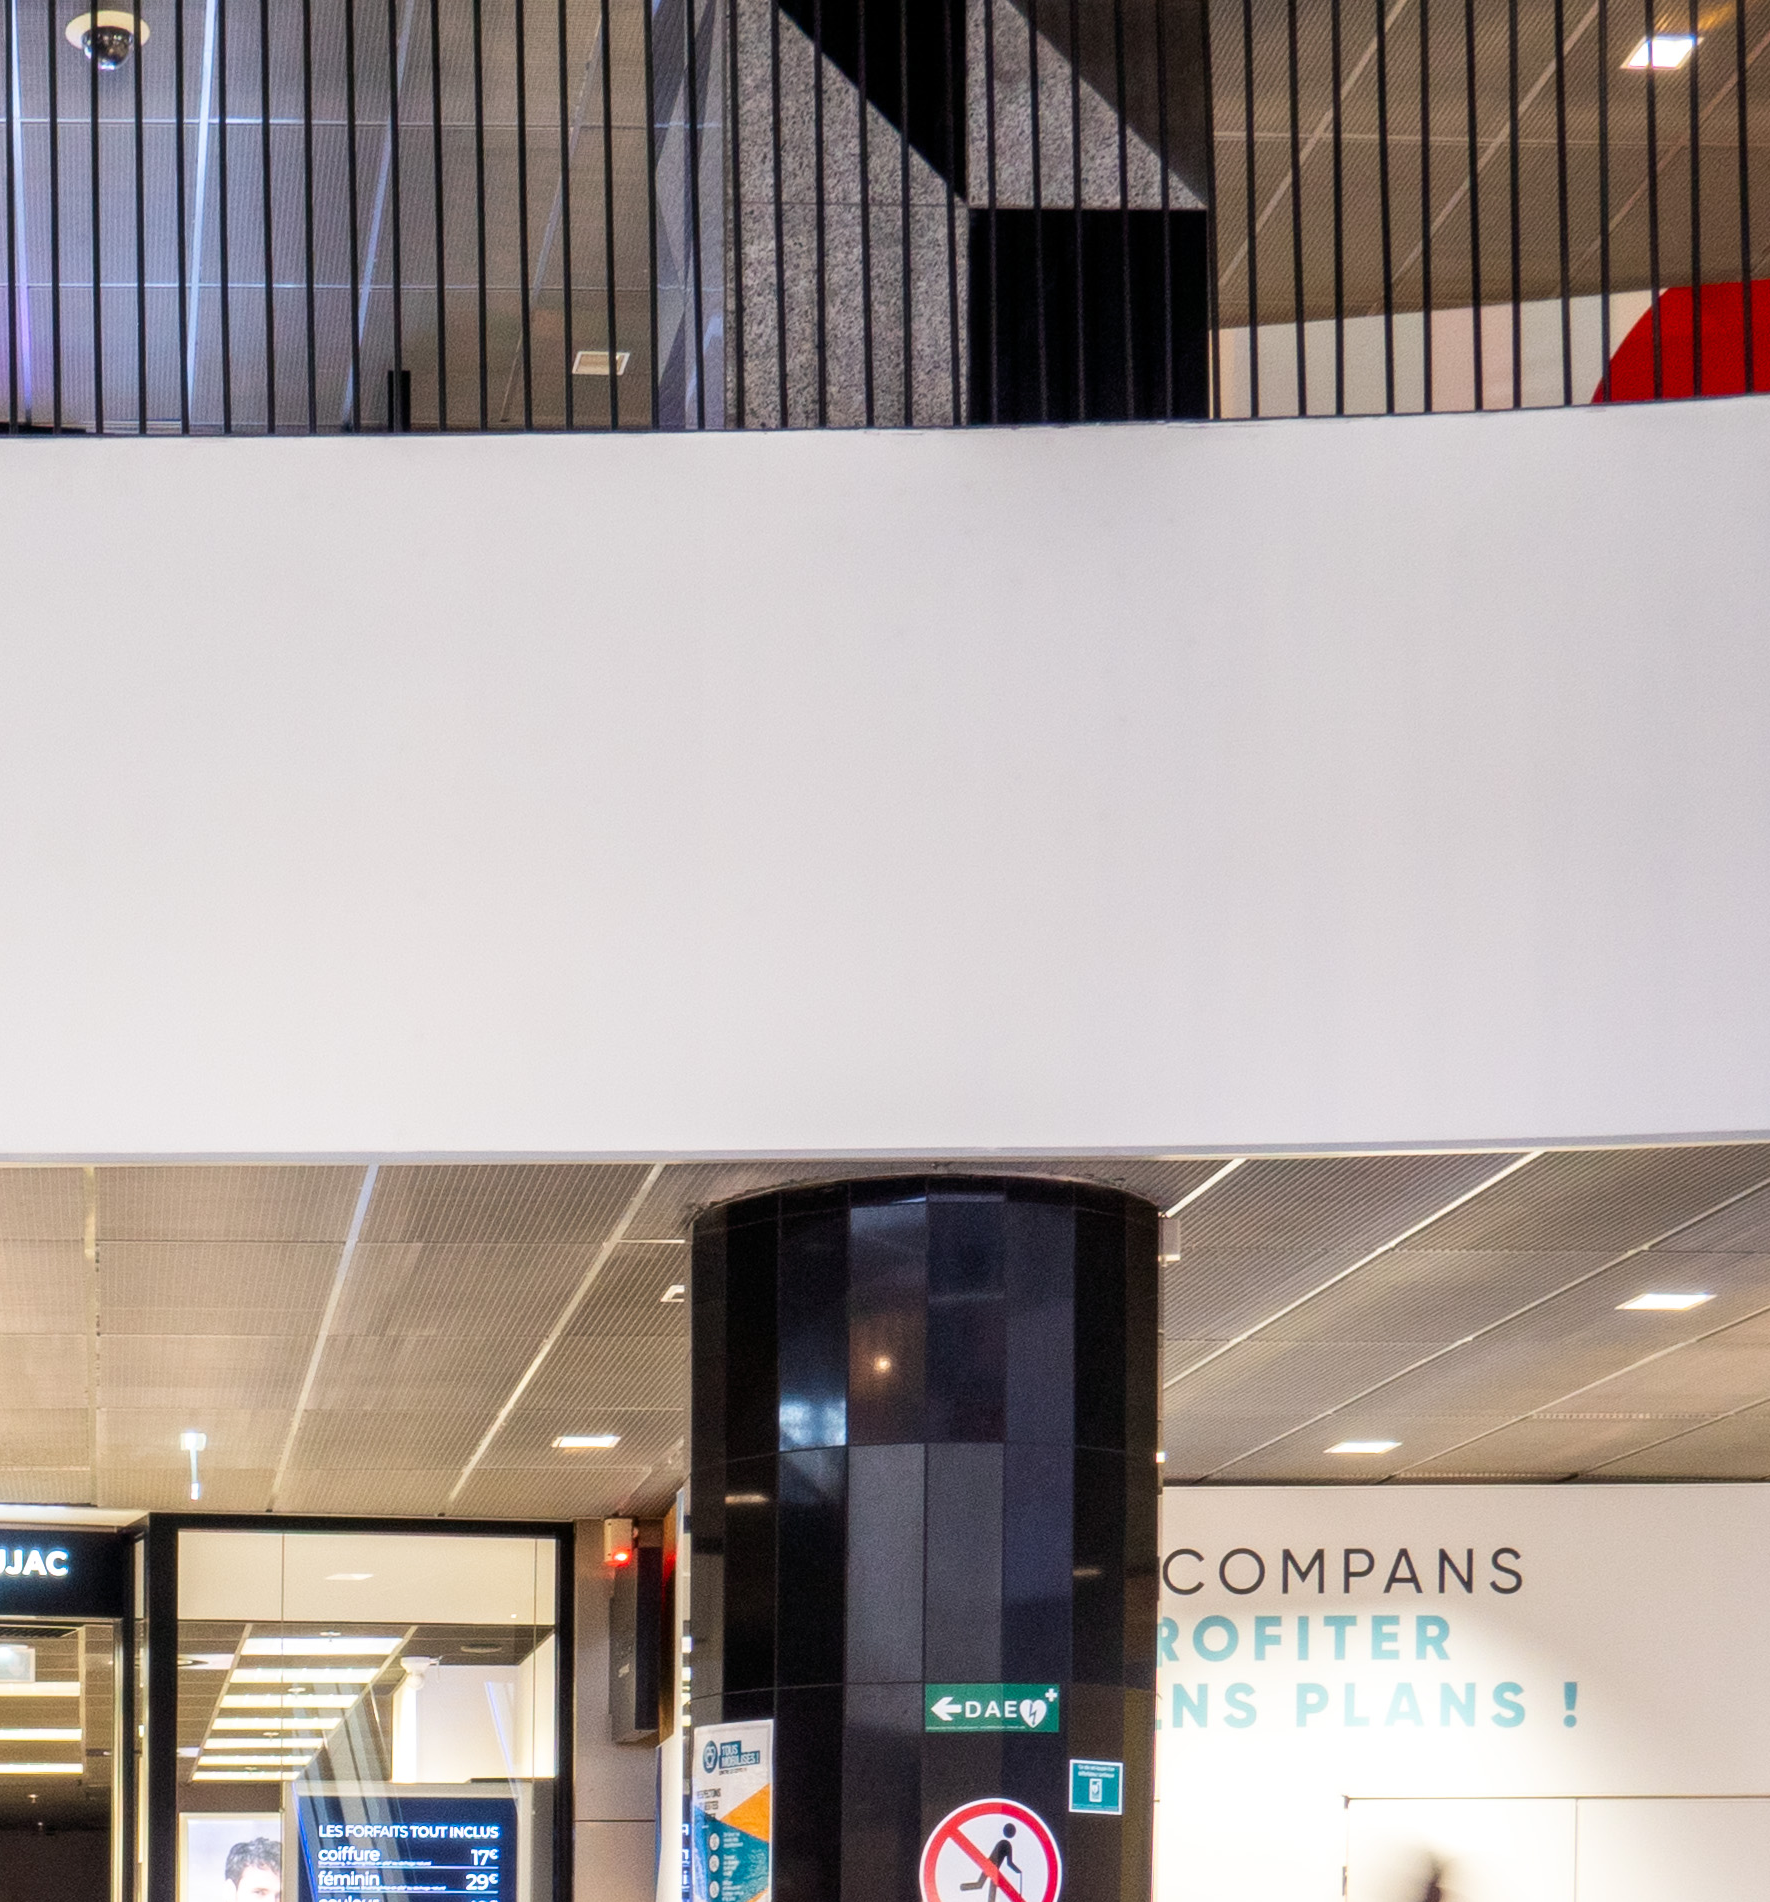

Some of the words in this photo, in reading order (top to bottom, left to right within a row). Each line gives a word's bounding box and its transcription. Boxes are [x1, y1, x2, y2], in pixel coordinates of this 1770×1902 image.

[1162, 1547, 1524, 1596] COMPANS
[965, 1700, 1018, 1718] DAE
[1296, 1681, 1527, 1729] PLANS
[318, 1824, 343, 1838] LES
[345, 1825, 408, 1838] FORFAITS
[409, 1825, 448, 1839] TOUT
[449, 1826, 499, 1839] INCLUS
[318, 1845, 381, 1862] coiffure
[470, 1848, 499, 1866] 17€
[318, 1871, 380, 1886] féminin
[465, 1873, 499, 1891] 29€
